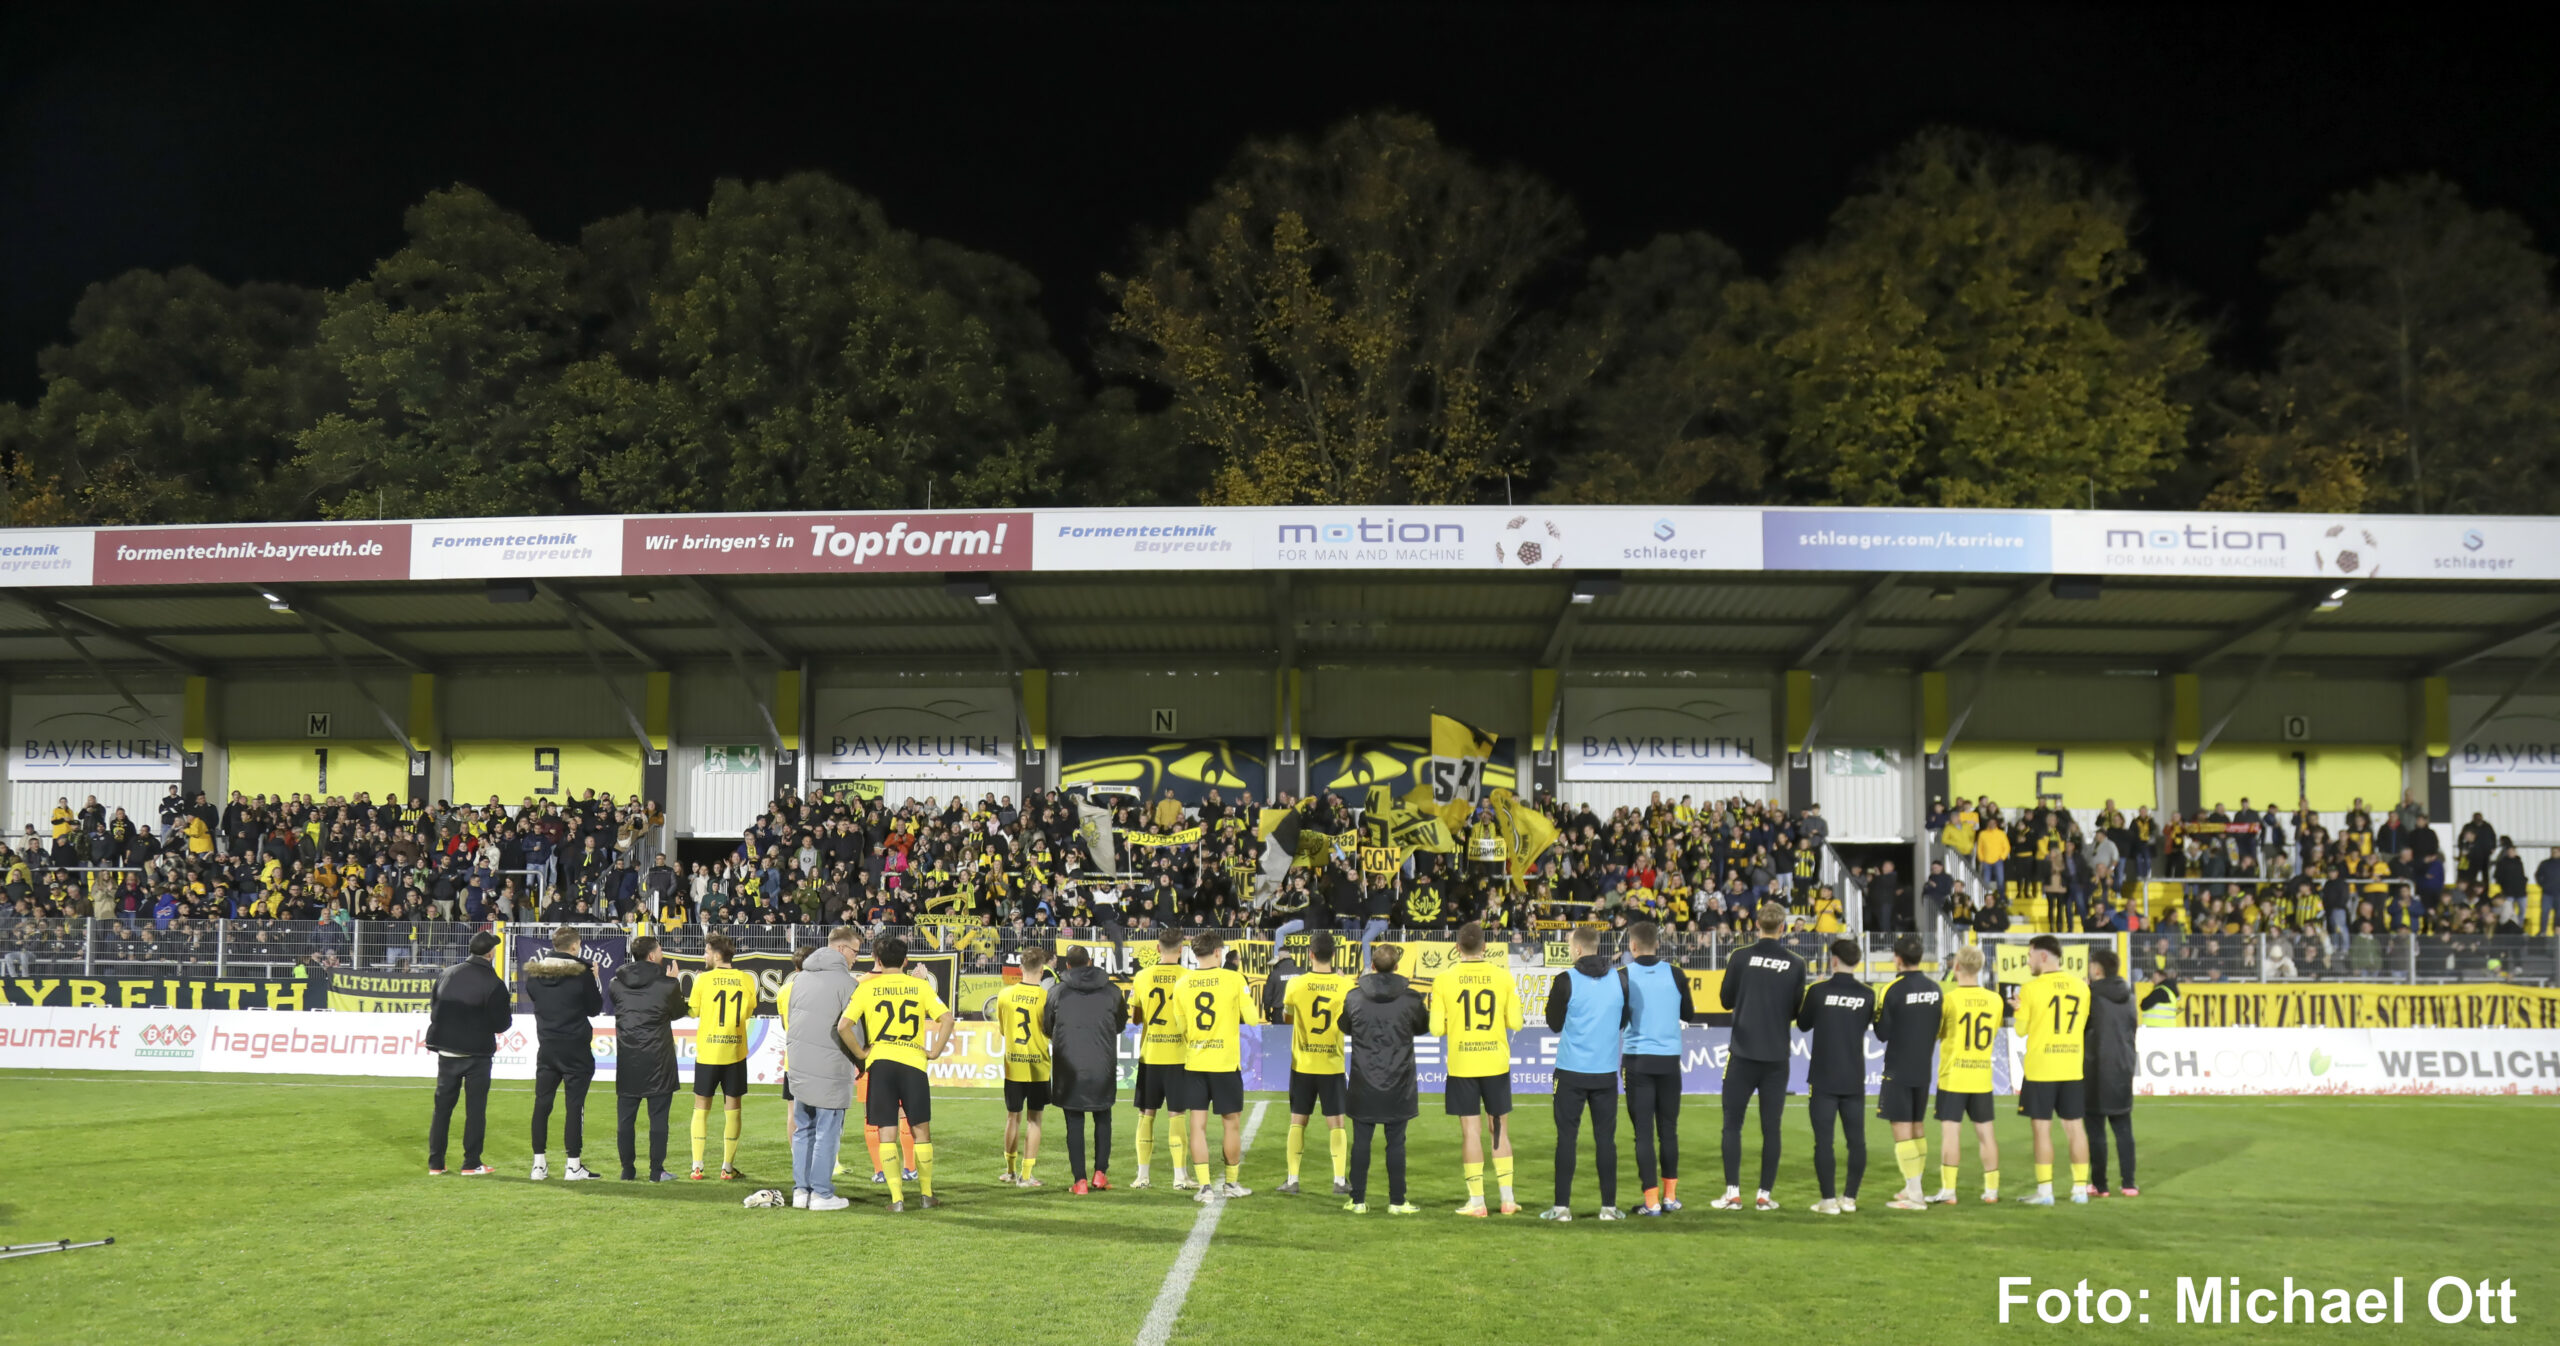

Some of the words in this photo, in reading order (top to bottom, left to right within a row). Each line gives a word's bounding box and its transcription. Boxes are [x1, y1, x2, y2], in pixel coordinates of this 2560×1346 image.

[1058, 523, 1217, 538] Formentechnik
[1278, 517, 1465, 543] motion
[2106, 524, 2287, 550] motion
[432, 532, 578, 548] Formentechnik
[645, 534, 678, 550] Wir
[776, 533, 795, 549] in
[809, 522, 1009, 565] Topform!
[1133, 539, 1233, 554] Bayreuth
[1799, 530, 2025, 549] schlaeger.com/karriere
[0, 544, 60, 557] echnik
[116, 540, 383, 562] formentechnik-bayreuth.de
[502, 547, 593, 562] Bayreuth
[1278, 548, 1308, 561] FOR
[1314, 548, 1349, 561] MAN
[1356, 548, 1389, 561] AND
[1396, 548, 1466, 561] MACHINE
[1623, 545, 1707, 563] schlaeger
[2106, 555, 2134, 567] FOR
[2142, 555, 2175, 567] MAN
[2182, 555, 2213, 568] AND
[2221, 556, 2287, 569] MACHINE
[2434, 555, 2516, 571] schlaeger
[309, 714, 328, 735] M
[1156, 711, 1173, 731] N
[24, 738, 171, 767] BAYREUTH
[831, 734, 998, 765] BAYREUTH
[1582, 735, 1755, 766] BAYREUTH
[829, 781, 880, 795] ALTSTADT
[1763, 959, 1790, 972] cep
[1152, 975, 1177, 984] WEBER
[1188, 978, 1220, 989] SCHEDER
[1307, 982, 1339, 993] SCHWARZ
[1458, 975, 1492, 984] GÖRTLER
[1011, 995, 1039, 1005] LIPPERT
[1838, 995, 1866, 1010] cep
[1918, 992, 1940, 1005] cep
[713, 990, 743, 1028] 11
[1194, 991, 1216, 1031] 8
[1311, 996, 1332, 1035] 5
[1456, 988, 1496, 1032] 19
[2048, 994, 2080, 1034] 17
[874, 1000, 920, 1042] 25
[1014, 1007, 1032, 1045] 3
[1958, 1012, 1993, 1051] 16
[2378, 1050, 2560, 1078] WEDLICH
